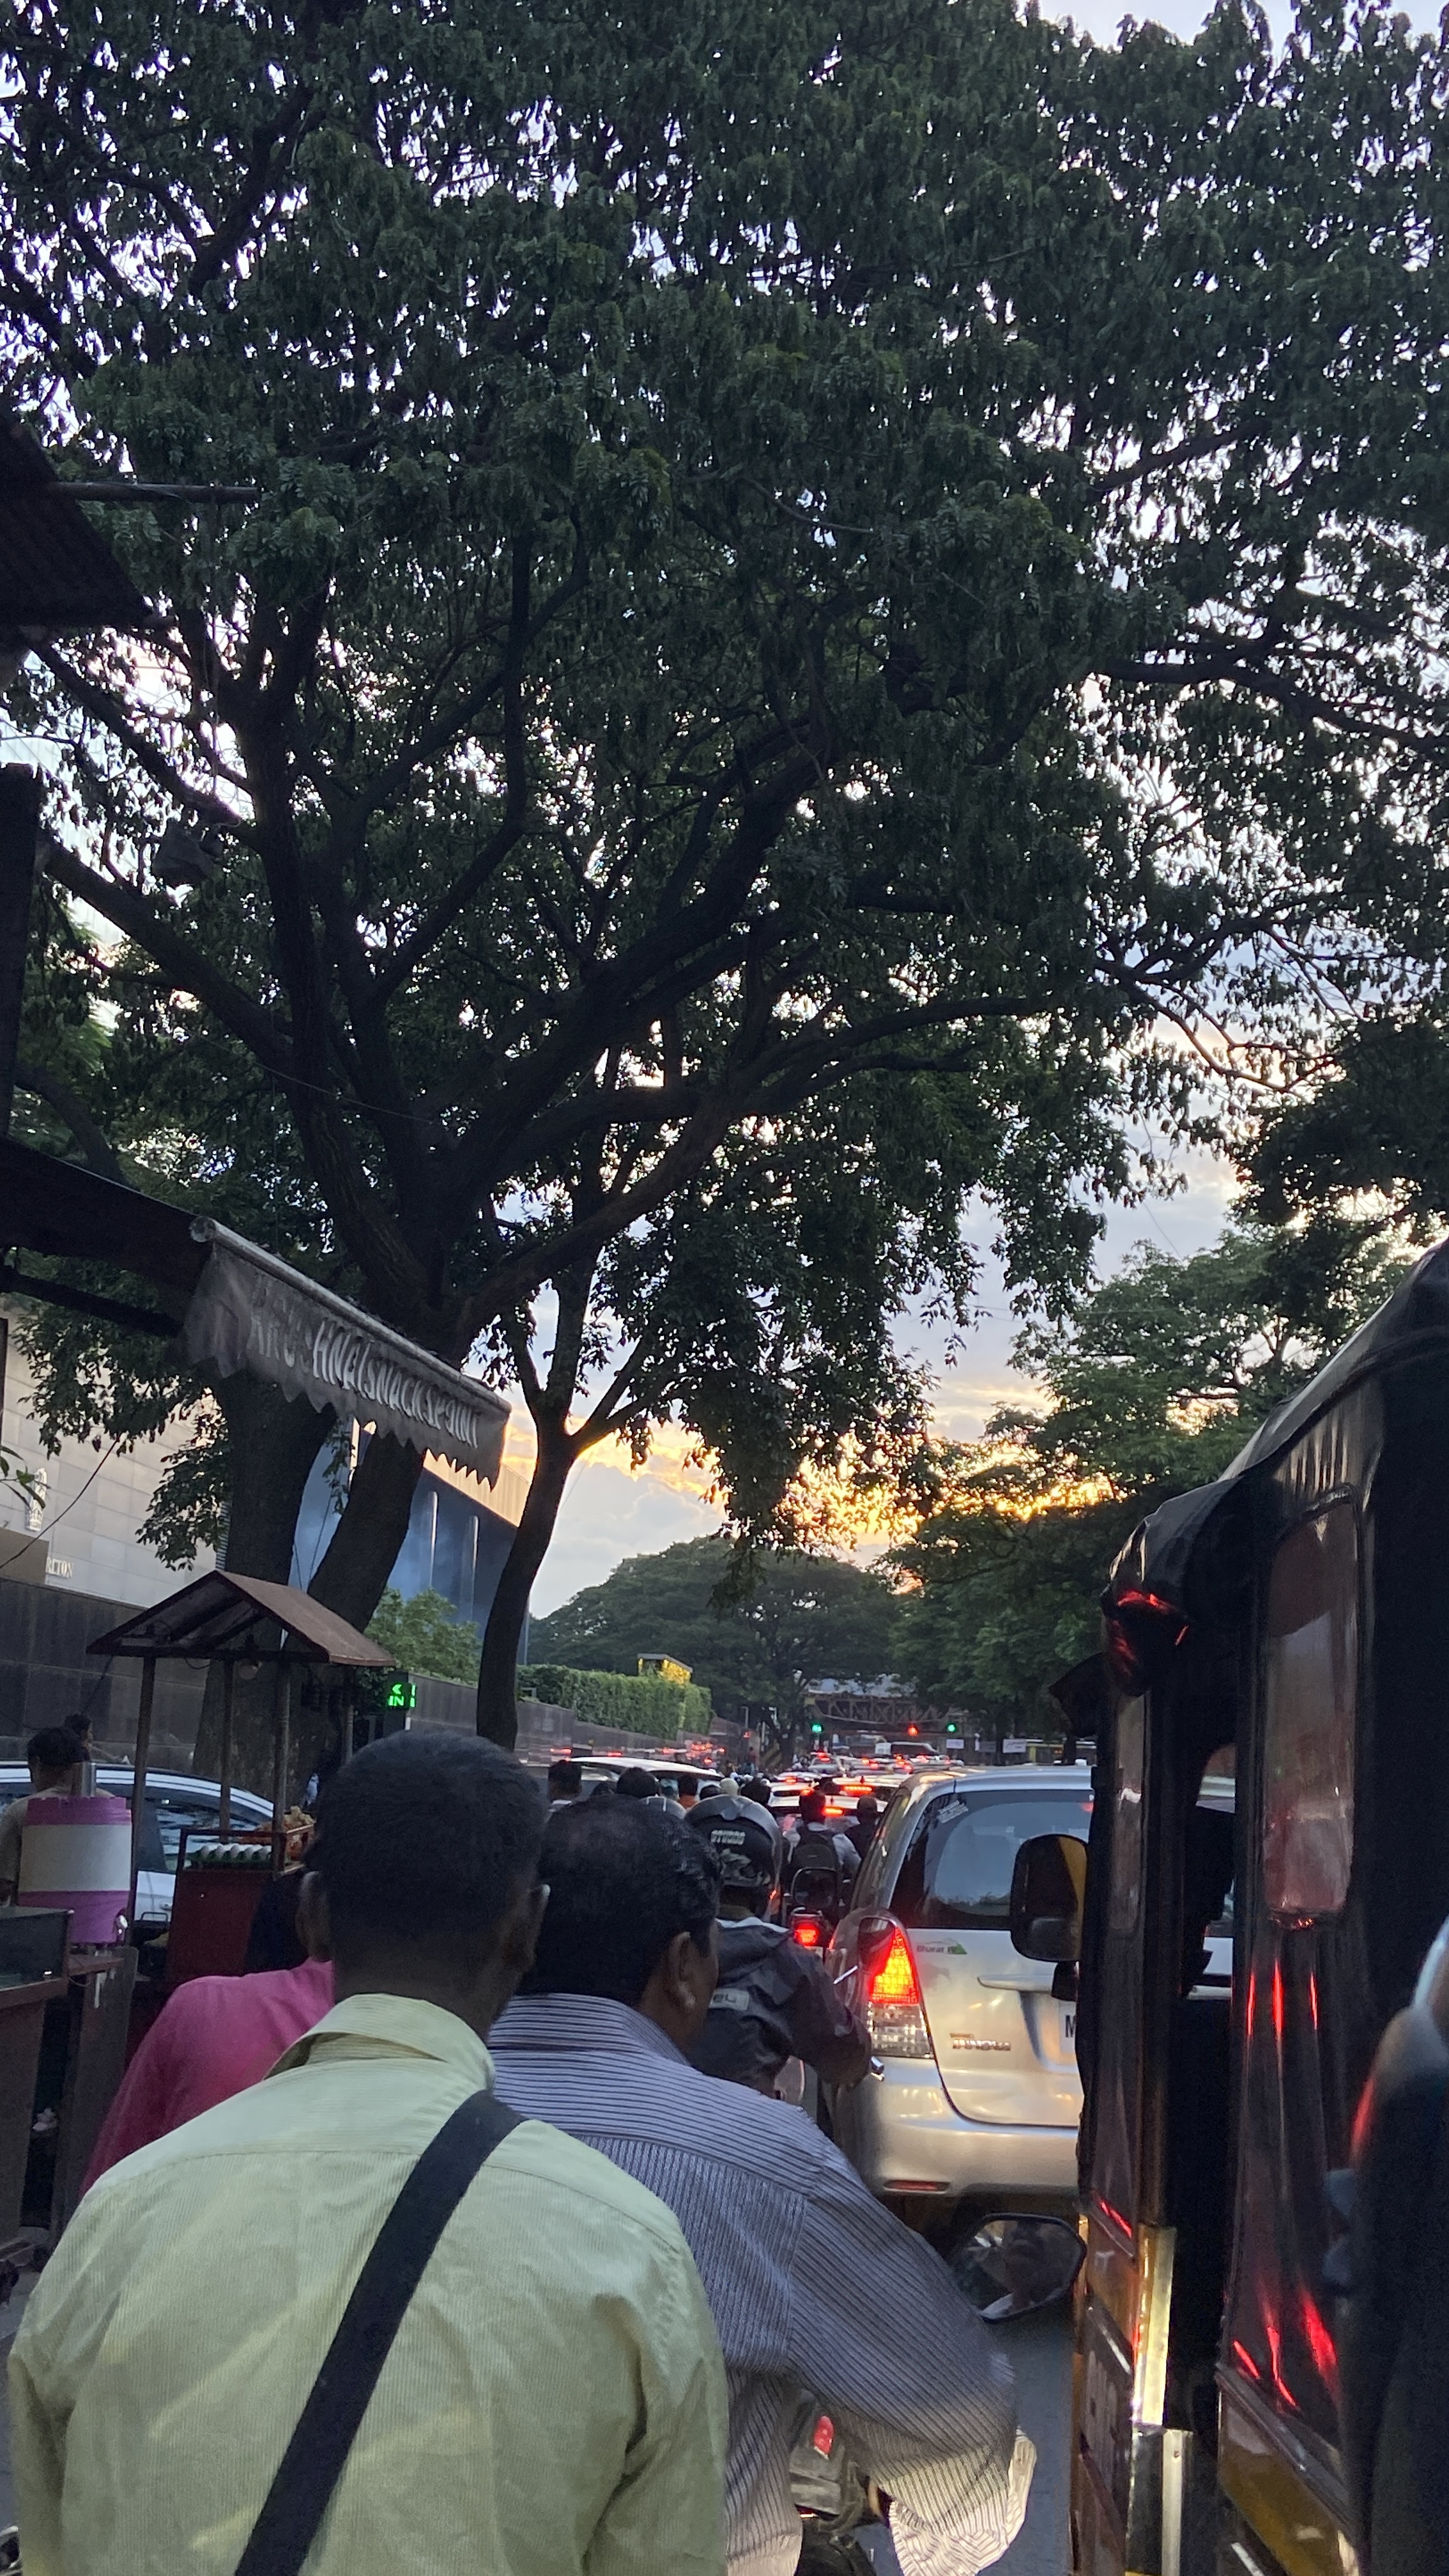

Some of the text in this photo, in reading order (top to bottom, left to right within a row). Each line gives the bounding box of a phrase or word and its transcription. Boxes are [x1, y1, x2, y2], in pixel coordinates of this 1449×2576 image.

[45, 1556, 73, 1578] RLTON
[388, 1696, 404, 1706] IN
[917, 1945, 944, 1953] Bharat
